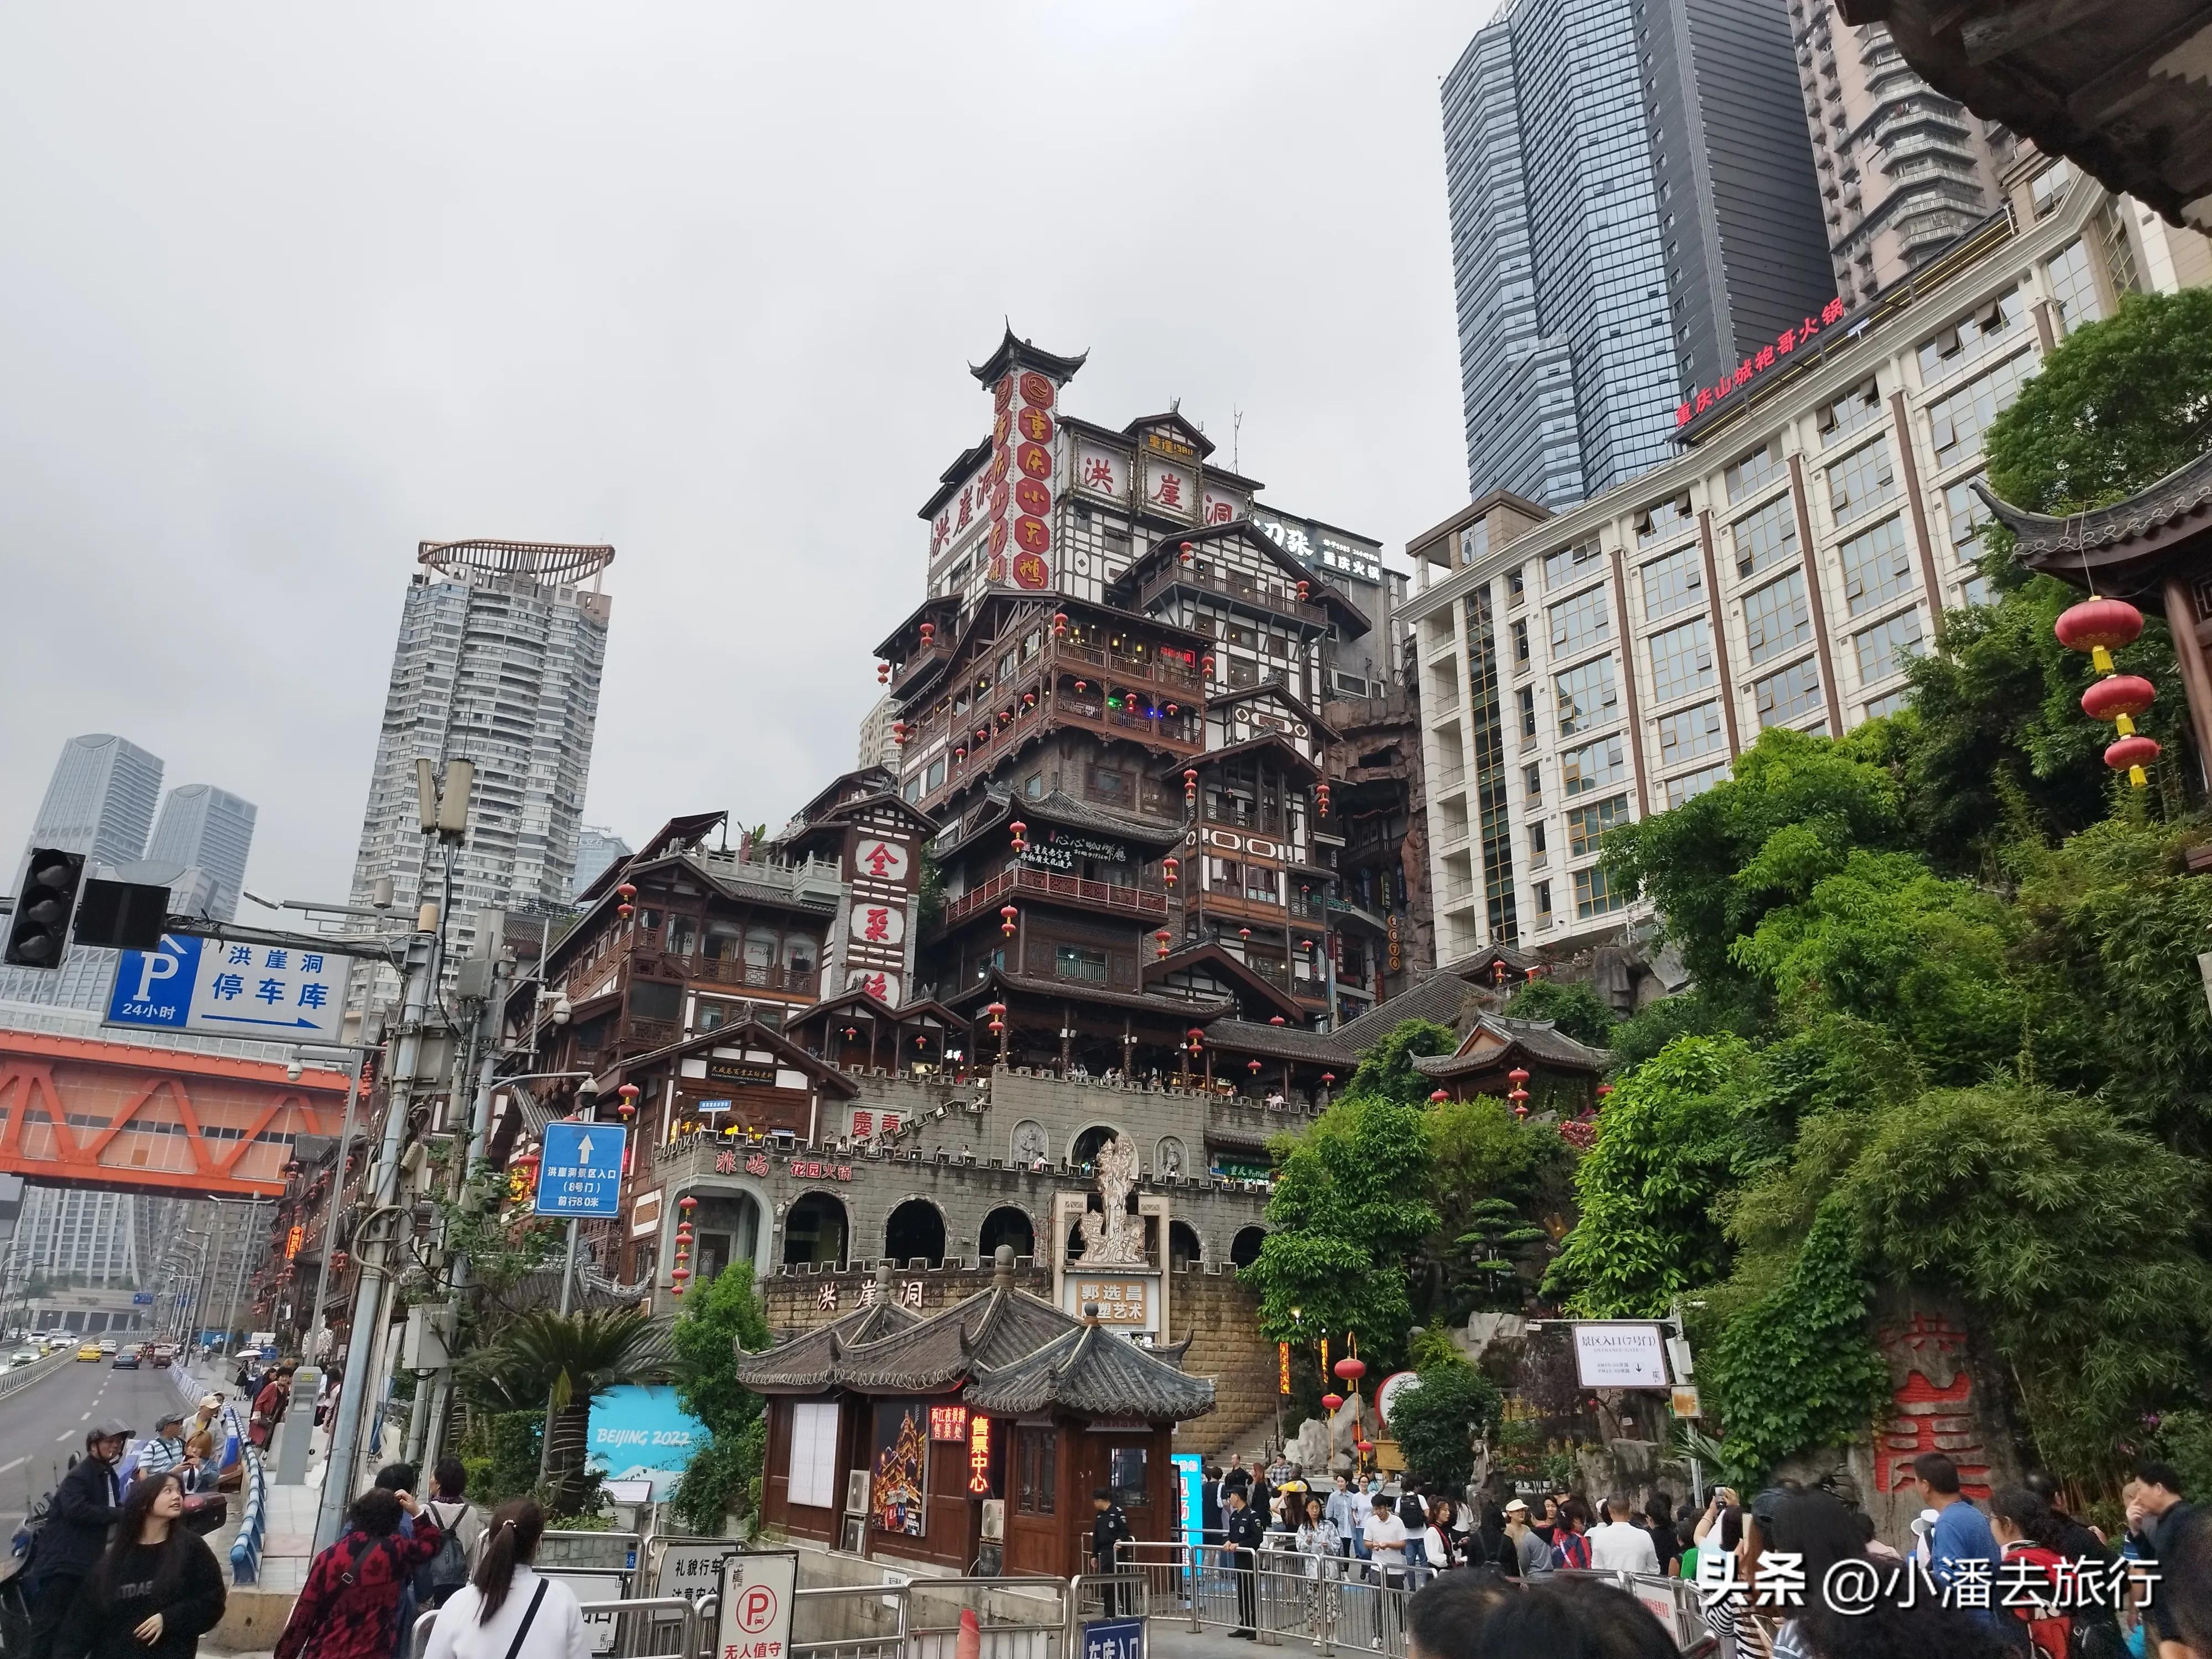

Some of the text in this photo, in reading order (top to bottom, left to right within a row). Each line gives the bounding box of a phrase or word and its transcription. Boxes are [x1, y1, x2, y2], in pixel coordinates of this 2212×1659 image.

[1676, 297, 1844, 428] 重庆山城袍哥火锅
[1019, 409, 1047, 587] 重庆小天鹅
[1084, 457, 1233, 525] 洪崖洞
[1323, 551, 1380, 581] 重庆火锅
[1018, 852, 1073, 869] 非物质文化遗产
[1032, 843, 1072, 861] 重庆老字号
[228, 945, 325, 974] 洪崖洞
[212, 972, 330, 1010] 停车库
[122, 1003, 176, 1020] 24小时
[547, 1166, 616, 1180] 洪崖洞景区入口
[790, 1160, 853, 1181] 花园火锅
[558, 1196, 599, 1207] 前行80米
[817, 1279, 924, 1311] 洪崖洞
[1081, 1284, 1142, 1302] 郭选昌
[597, 1428, 691, 1448] BEIJING 2022
[934, 1422, 962, 1439] 售票处
[969, 1416, 989, 1491] 售票中心
[675, 1558, 721, 1577] 礼貌行车
[724, 1641, 782, 1659] 无人值守
